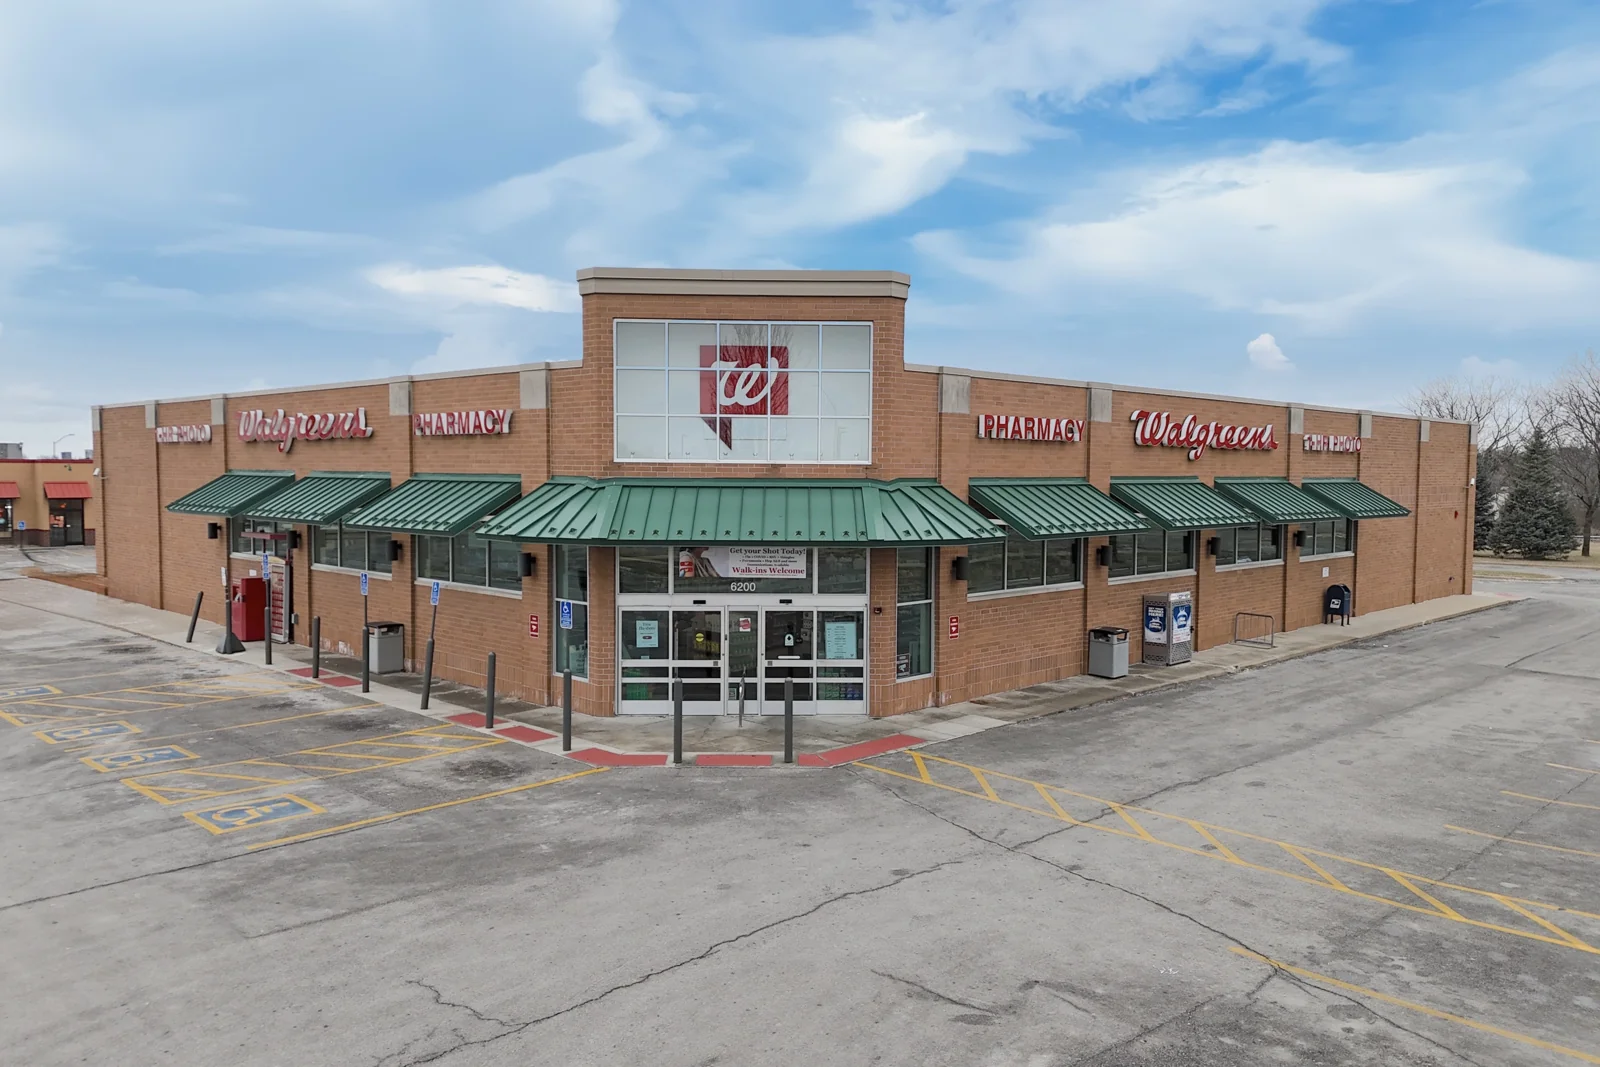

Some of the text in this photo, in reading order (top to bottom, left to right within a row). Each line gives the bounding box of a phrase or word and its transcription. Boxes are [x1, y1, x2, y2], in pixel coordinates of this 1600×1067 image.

[234, 407, 373, 453] Walgreens
[413, 409, 513, 436] PHARMACY
[979, 414, 1085, 442] PHARMACY
[1130, 410, 1279, 460] Walgreens
[1331, 435, 1361, 453] PHOTO
[781, 548, 806, 556] Today!
[730, 582, 756, 591] 6200
